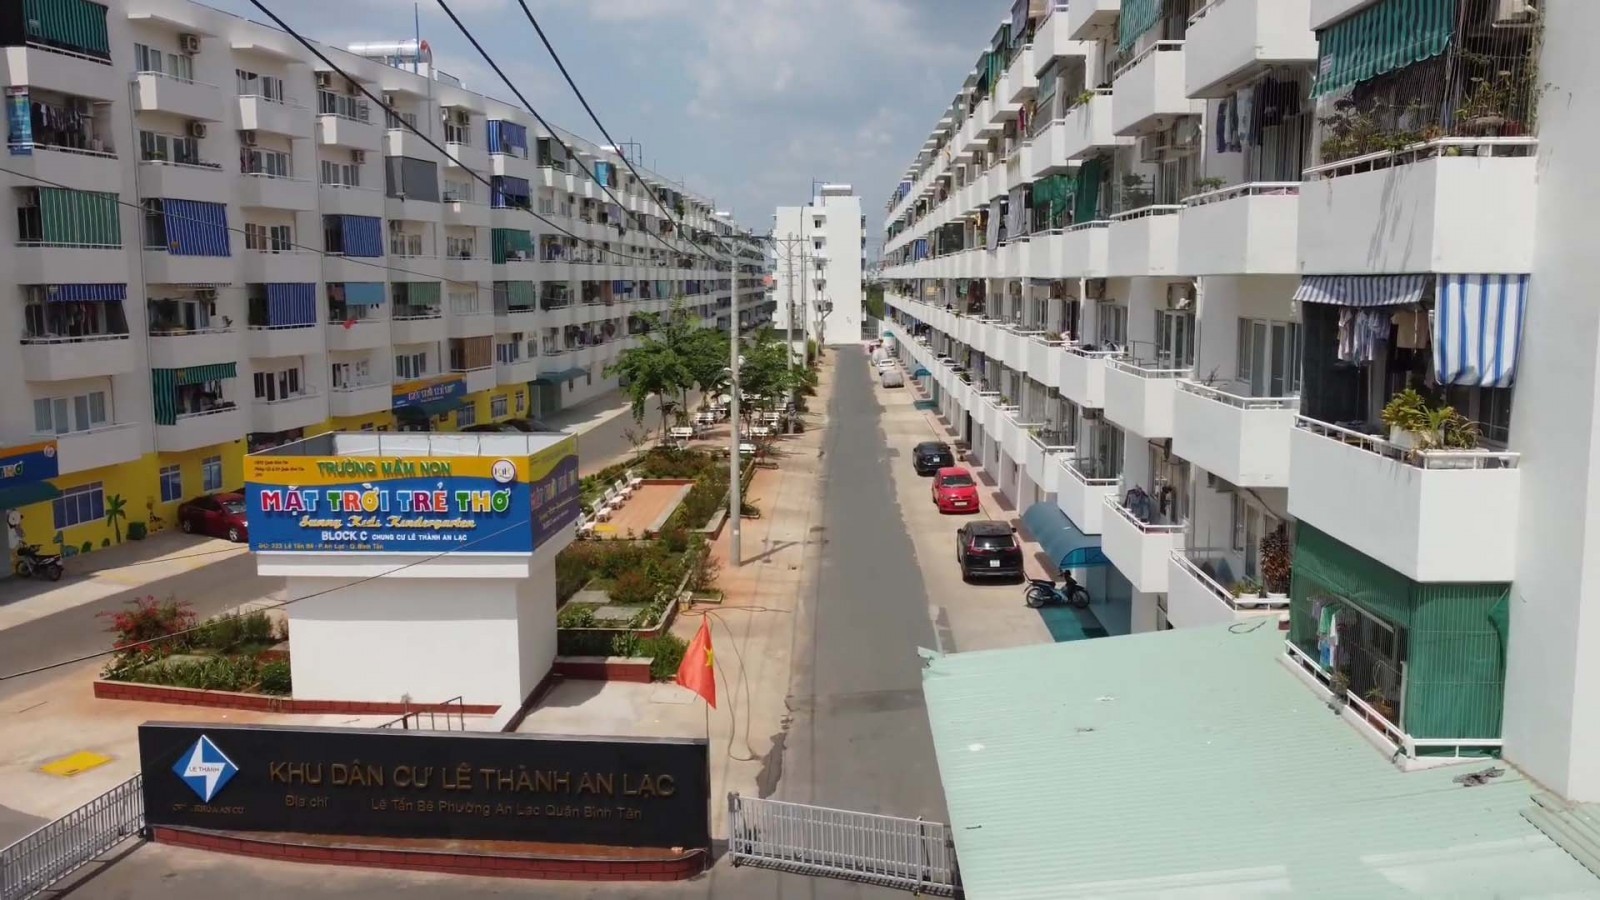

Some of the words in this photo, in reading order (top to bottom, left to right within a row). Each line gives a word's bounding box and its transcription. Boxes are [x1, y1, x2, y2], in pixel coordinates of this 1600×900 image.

[317, 458, 377, 476] TRƯỜNG
[381, 457, 416, 476] MẦM
[420, 460, 452, 476] NON
[260, 485, 319, 516] MẶT
[327, 483, 390, 513] TRỜI
[397, 482, 449, 513] TRẺ
[455, 488, 511, 513] THƠ
[299, 515, 343, 529] Sunny
[347, 515, 382, 528] Kids
[385, 515, 476, 529] Kindergarten
[321, 531, 358, 541] BLOCK
[359, 531, 368, 541] C
[396, 533, 406, 541] CƯ
[408, 532, 416, 541] LÊ
[418, 532, 441, 541] THÀNH
[453, 534, 468, 543] LẠC
[269, 761, 322, 784] KHU
[331, 758, 384, 787] DÂN
[393, 765, 433, 788] CƯ
[442, 762, 472, 790] LÊ
[480, 764, 570, 793] THÀNH
[577, 772, 614, 794] AN
[623, 773, 675, 798] LẠC
[371, 798, 387, 810] Lê
[391, 797, 413, 811] Tấn
[417, 800, 434, 812] Bê
[438, 800, 490, 817] Phường
[495, 802, 513, 815] An
